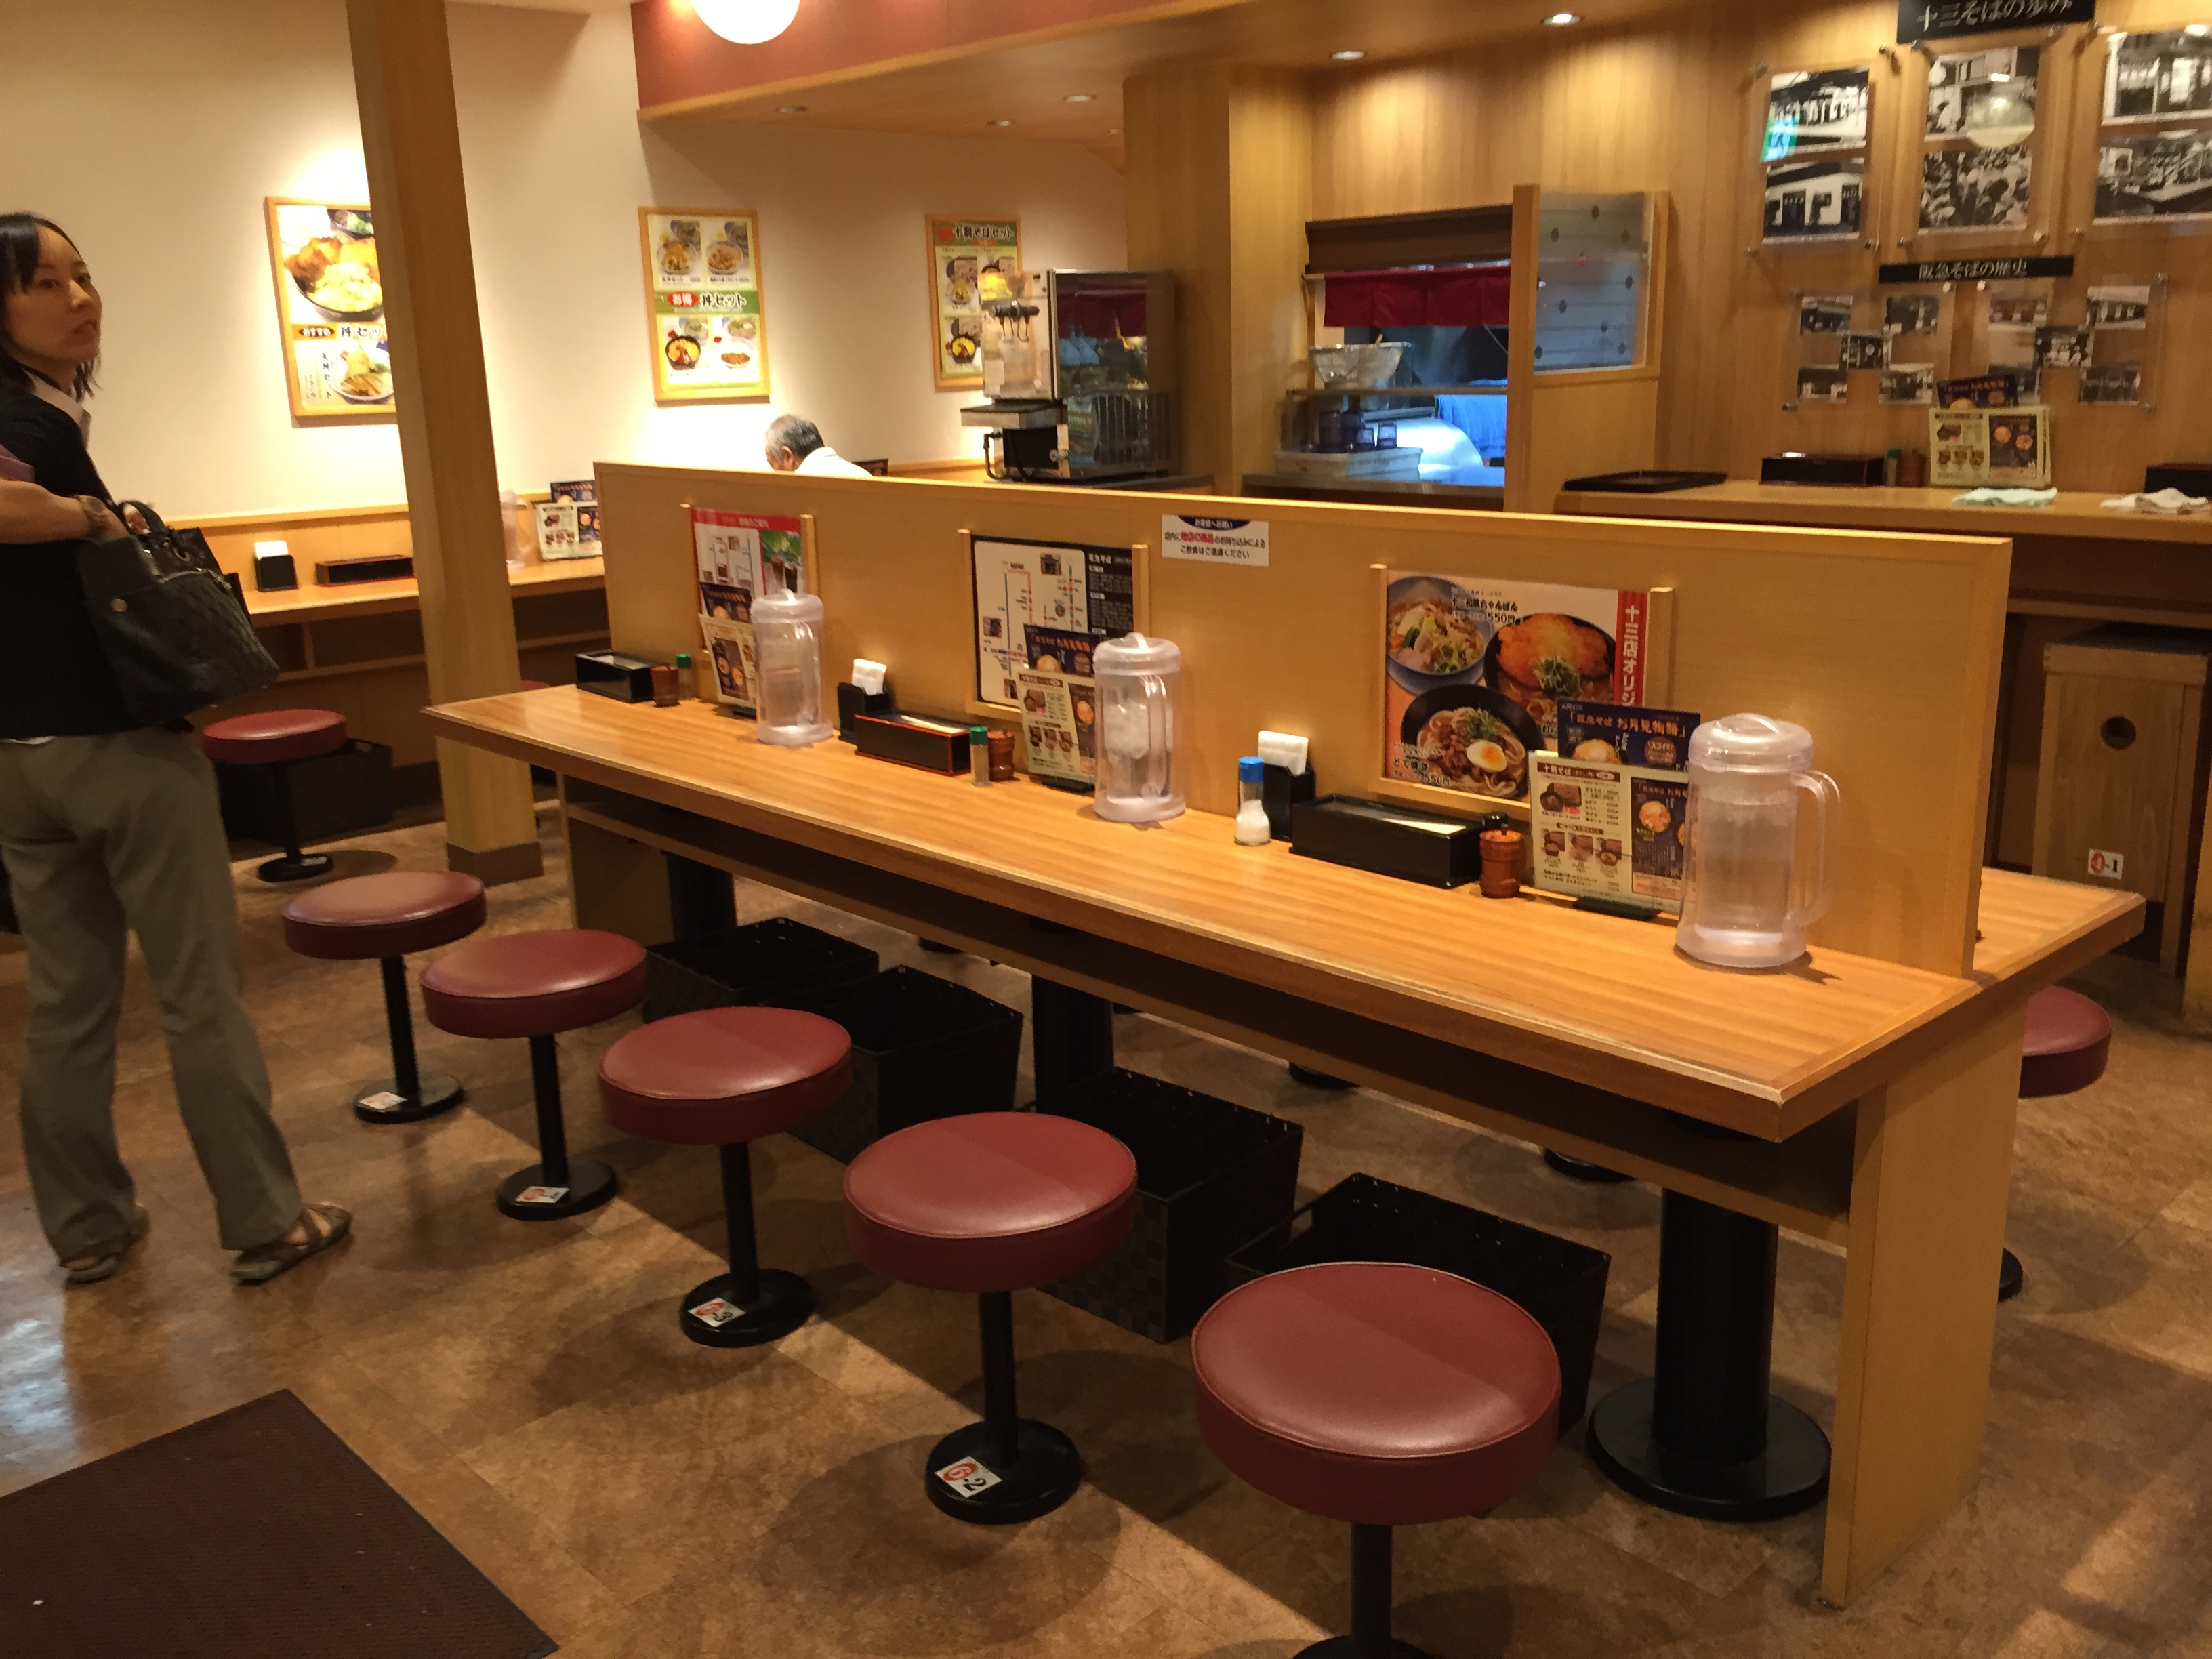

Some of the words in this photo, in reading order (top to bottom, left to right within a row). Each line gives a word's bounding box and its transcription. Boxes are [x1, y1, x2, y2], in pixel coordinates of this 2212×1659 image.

[1919, 258, 2028, 282] 阪急そばの歴史
[700, 291, 747, 307] 丼セット
